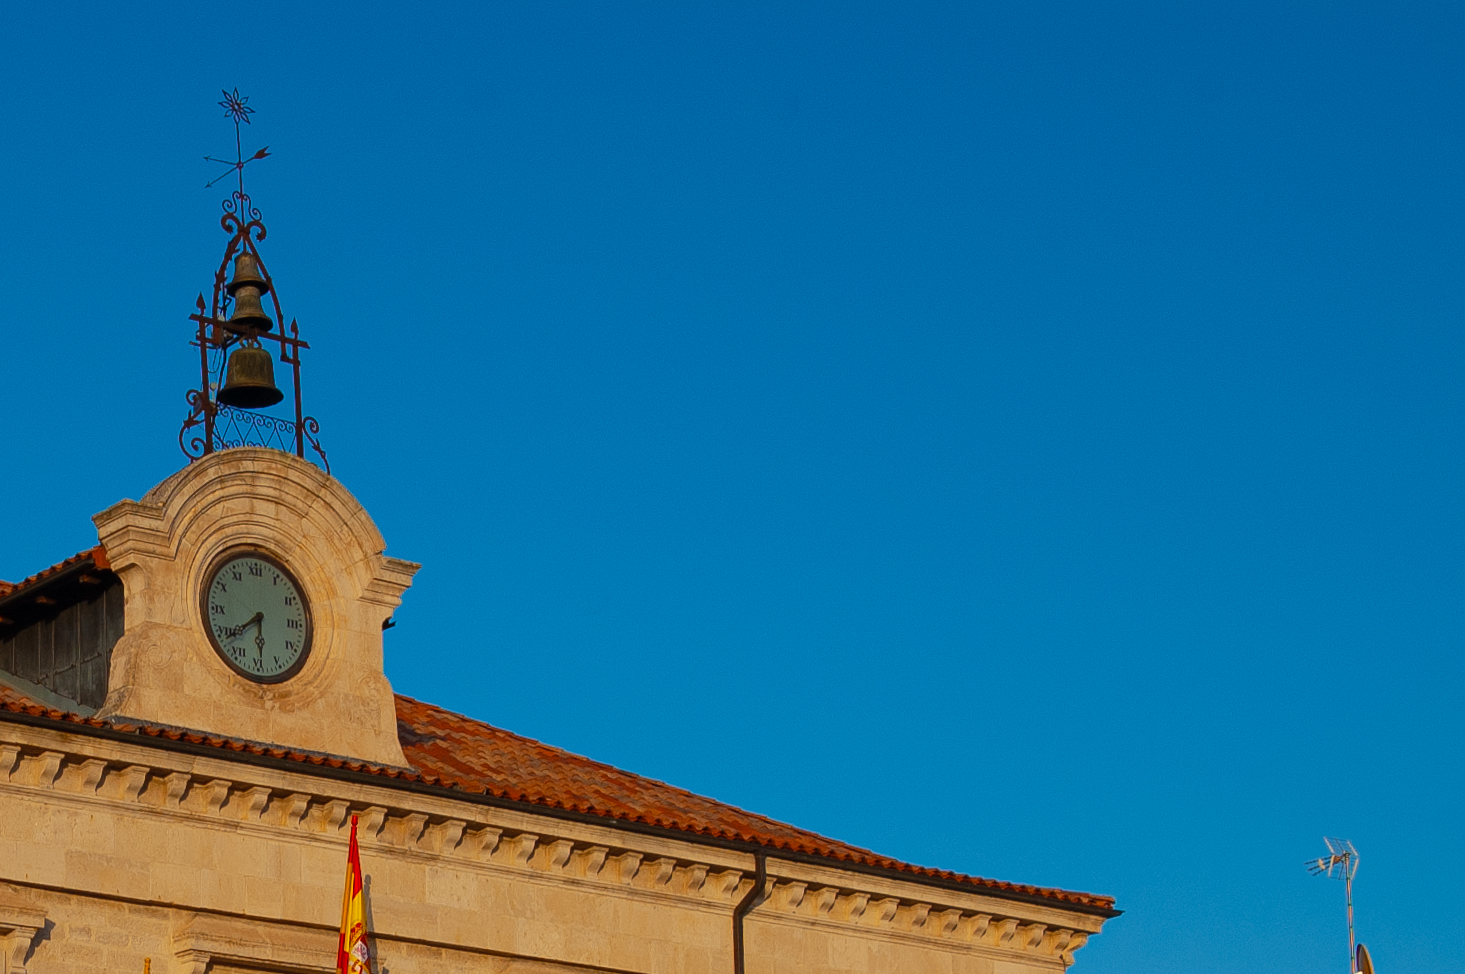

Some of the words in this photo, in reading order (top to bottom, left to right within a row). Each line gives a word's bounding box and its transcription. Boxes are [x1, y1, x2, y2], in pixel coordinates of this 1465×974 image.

[232, 571, 242, 581] XI
[248, 566, 262, 577] XII
[272, 576, 277, 586] I
[220, 582, 227, 592] X
[284, 596, 292, 606] II
[215, 604, 225, 614] IX
[287, 618, 298, 629] III
[285, 640, 295, 650] IV
[232, 646, 246, 657] VII
[253, 657, 263, 668] VI
[273, 656, 279, 666] V
